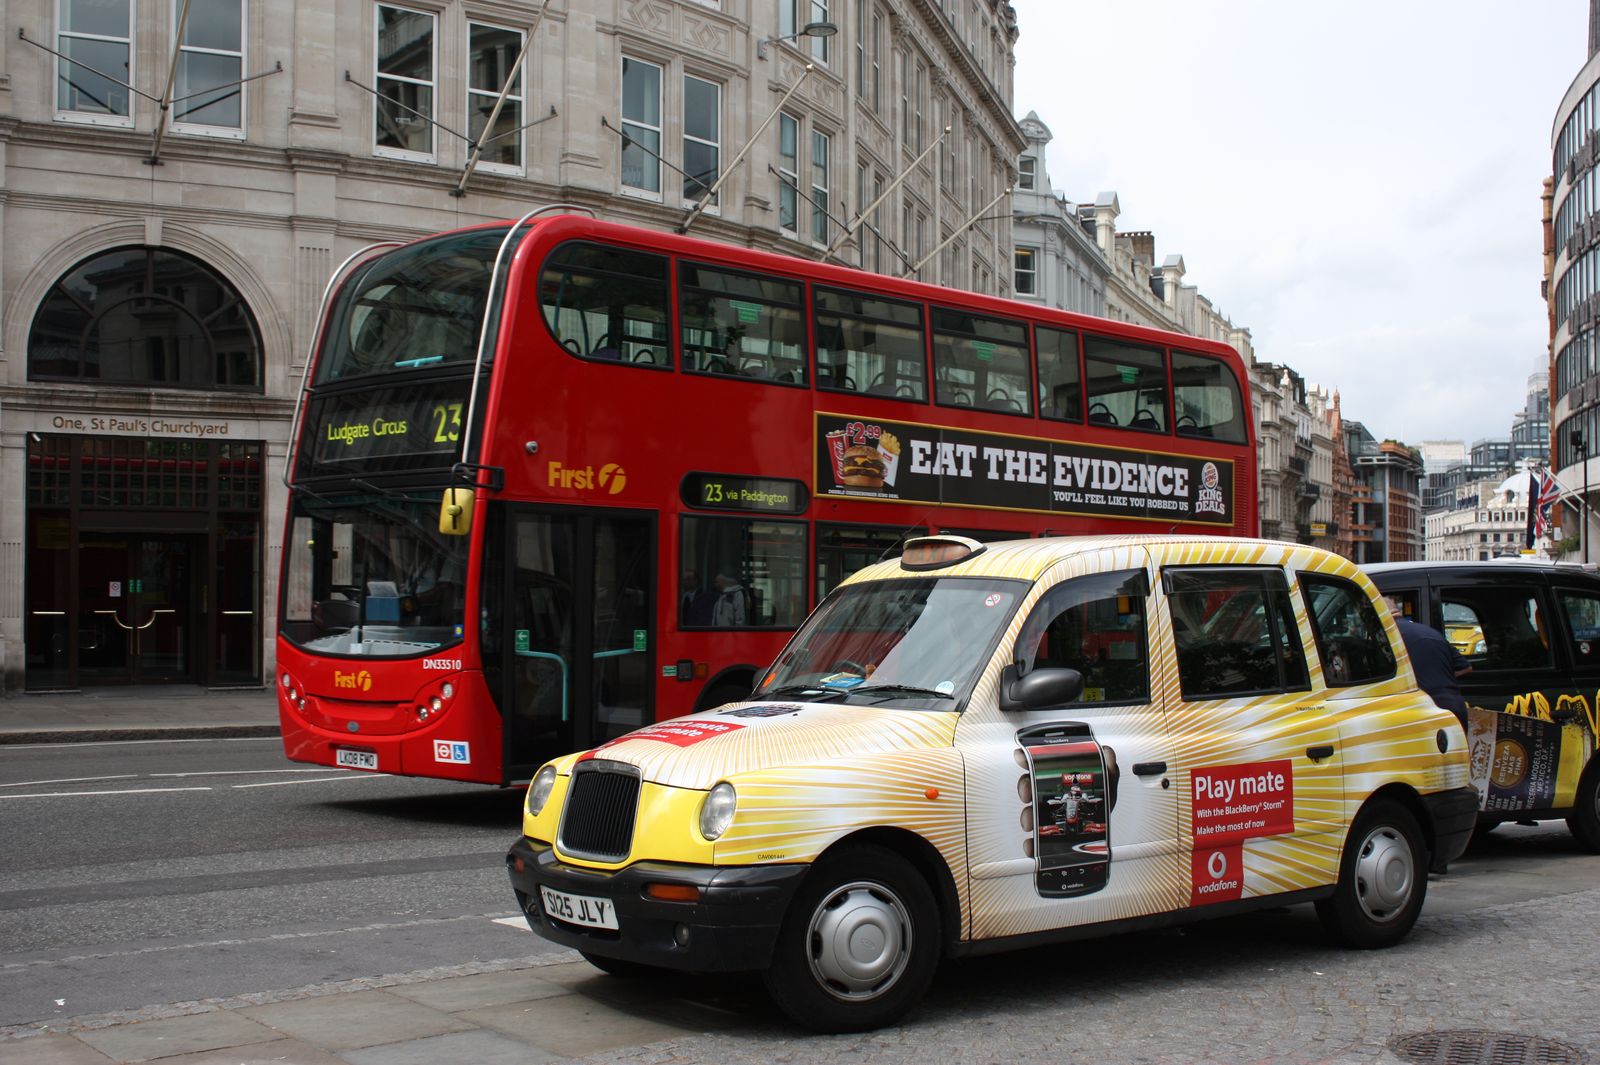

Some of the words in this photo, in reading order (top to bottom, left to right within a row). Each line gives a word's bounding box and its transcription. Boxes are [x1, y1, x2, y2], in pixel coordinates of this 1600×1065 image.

[52, 415, 86, 431] One,
[91, 418, 104, 430] St
[109, 418, 147, 431] Paul's
[151, 419, 228, 436] Churchyard
[327, 421, 369, 444] Ludgate
[373, 418, 407, 436] Circus
[433, 403, 462, 442] 23
[548, 461, 595, 490] First
[910, 439, 977, 477] EAT
[983, 446, 1047, 485] THE
[1053, 454, 1189, 497] EVIDENCE
[705, 483, 723, 502] 23
[726, 489, 738, 500] via
[741, 489, 789, 506] Paddington
[1053, 491, 1083, 503] YOU'LL
[1084, 493, 1107, 505] FEEL
[1107, 495, 1128, 506] LIKE
[1129, 497, 1145, 508] YOU
[1147, 498, 1178, 510] ROBBED
[1178, 501, 1189, 511] US
[1198, 489, 1223, 503] KING
[1195, 500, 1226, 515] DEALS
[423, 658, 462, 670] DN33510
[335, 671, 357, 689] First
[1499, 745, 1510, 782] CERVEZA
[1514, 756, 1522, 776] FINA
[1195, 775, 1235, 803] Play
[1240, 771, 1285, 795] mate
[1197, 808, 1212, 819] With
[1213, 807, 1224, 817] the
[1197, 825, 1214, 836] Make
[1215, 823, 1226, 833] the
[1227, 821, 1244, 832] most
[1244, 819, 1252, 829] of
[1252, 820, 1266, 828] now
[1198, 879, 1238, 894] vodafone
[546, 891, 574, 919] S125
[578, 899, 605, 924] JLY
